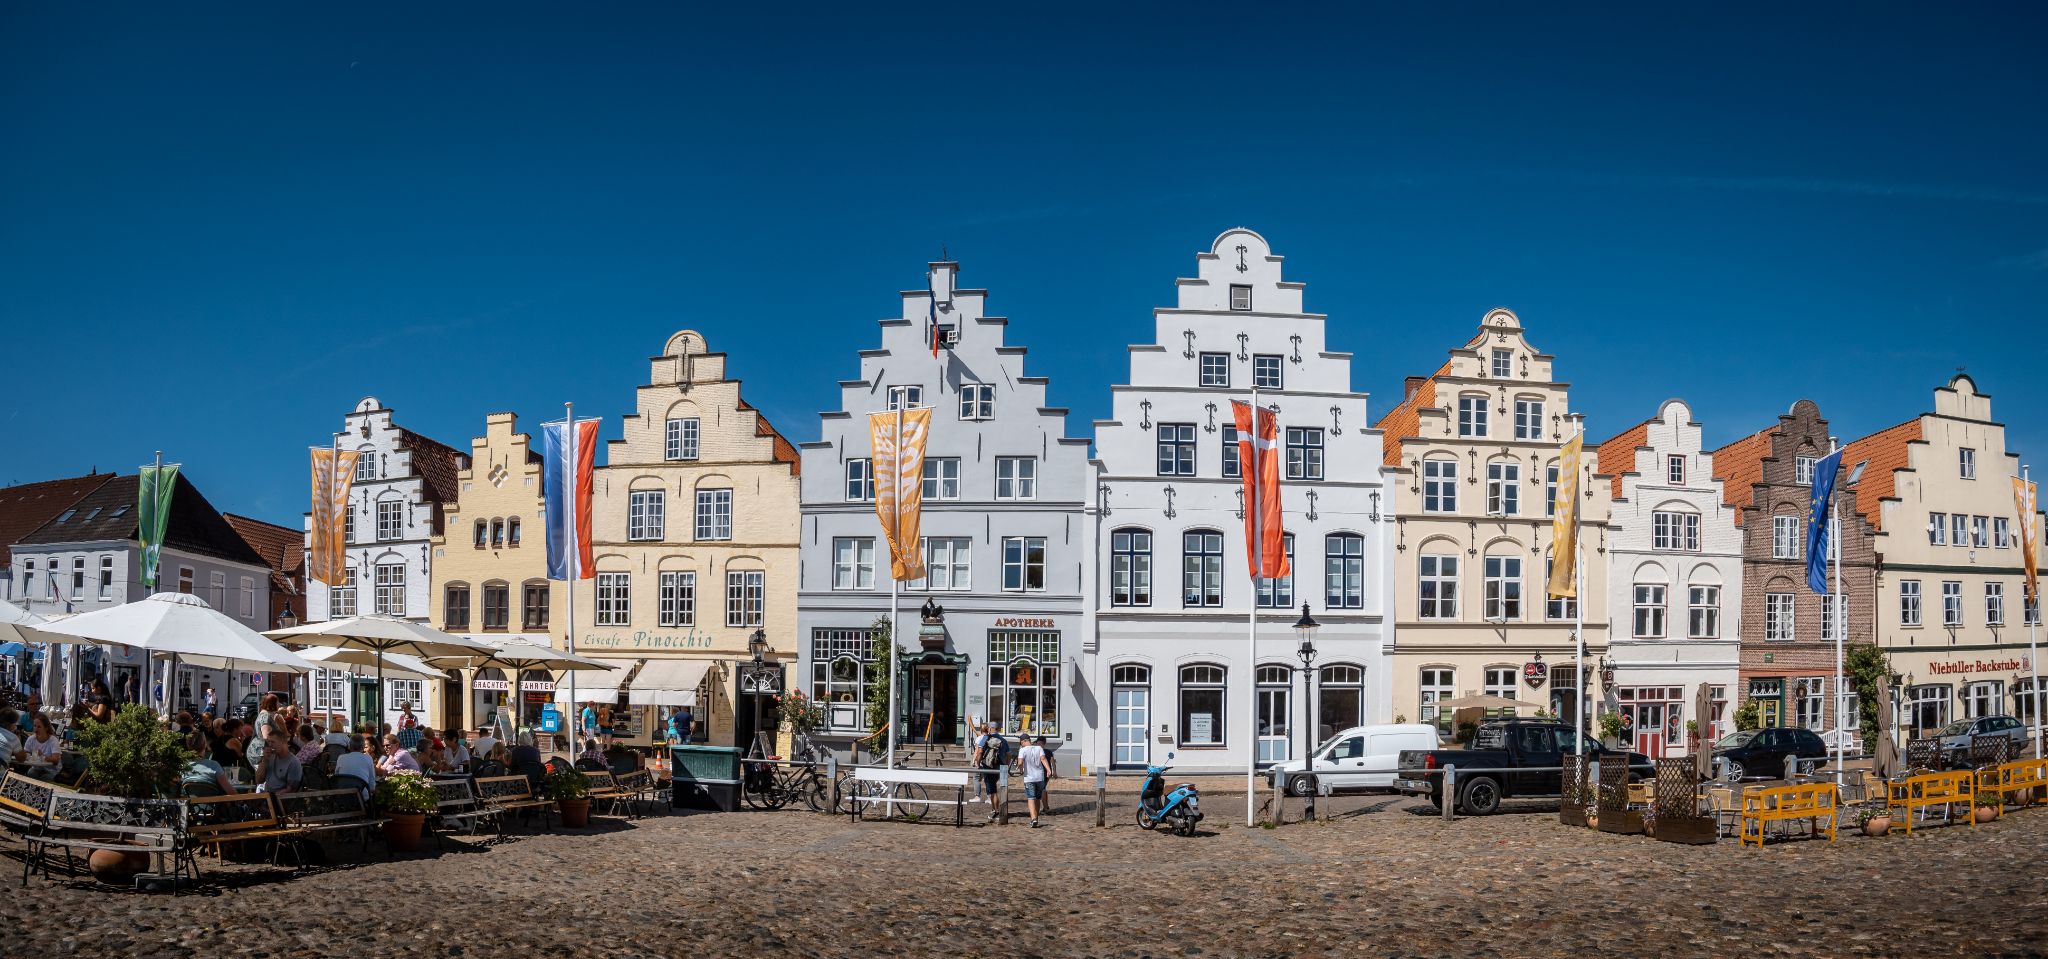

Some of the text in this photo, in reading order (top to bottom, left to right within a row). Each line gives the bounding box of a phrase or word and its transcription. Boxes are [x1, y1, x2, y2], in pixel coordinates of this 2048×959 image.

[995, 618, 1055, 628] APOTHEKE
[633, 628, 713, 648] Pinocchio
[1929, 659, 2020, 675] Niebüller Backstube
[473, 680, 554, 691] GRACHTEN FAHRTEN
